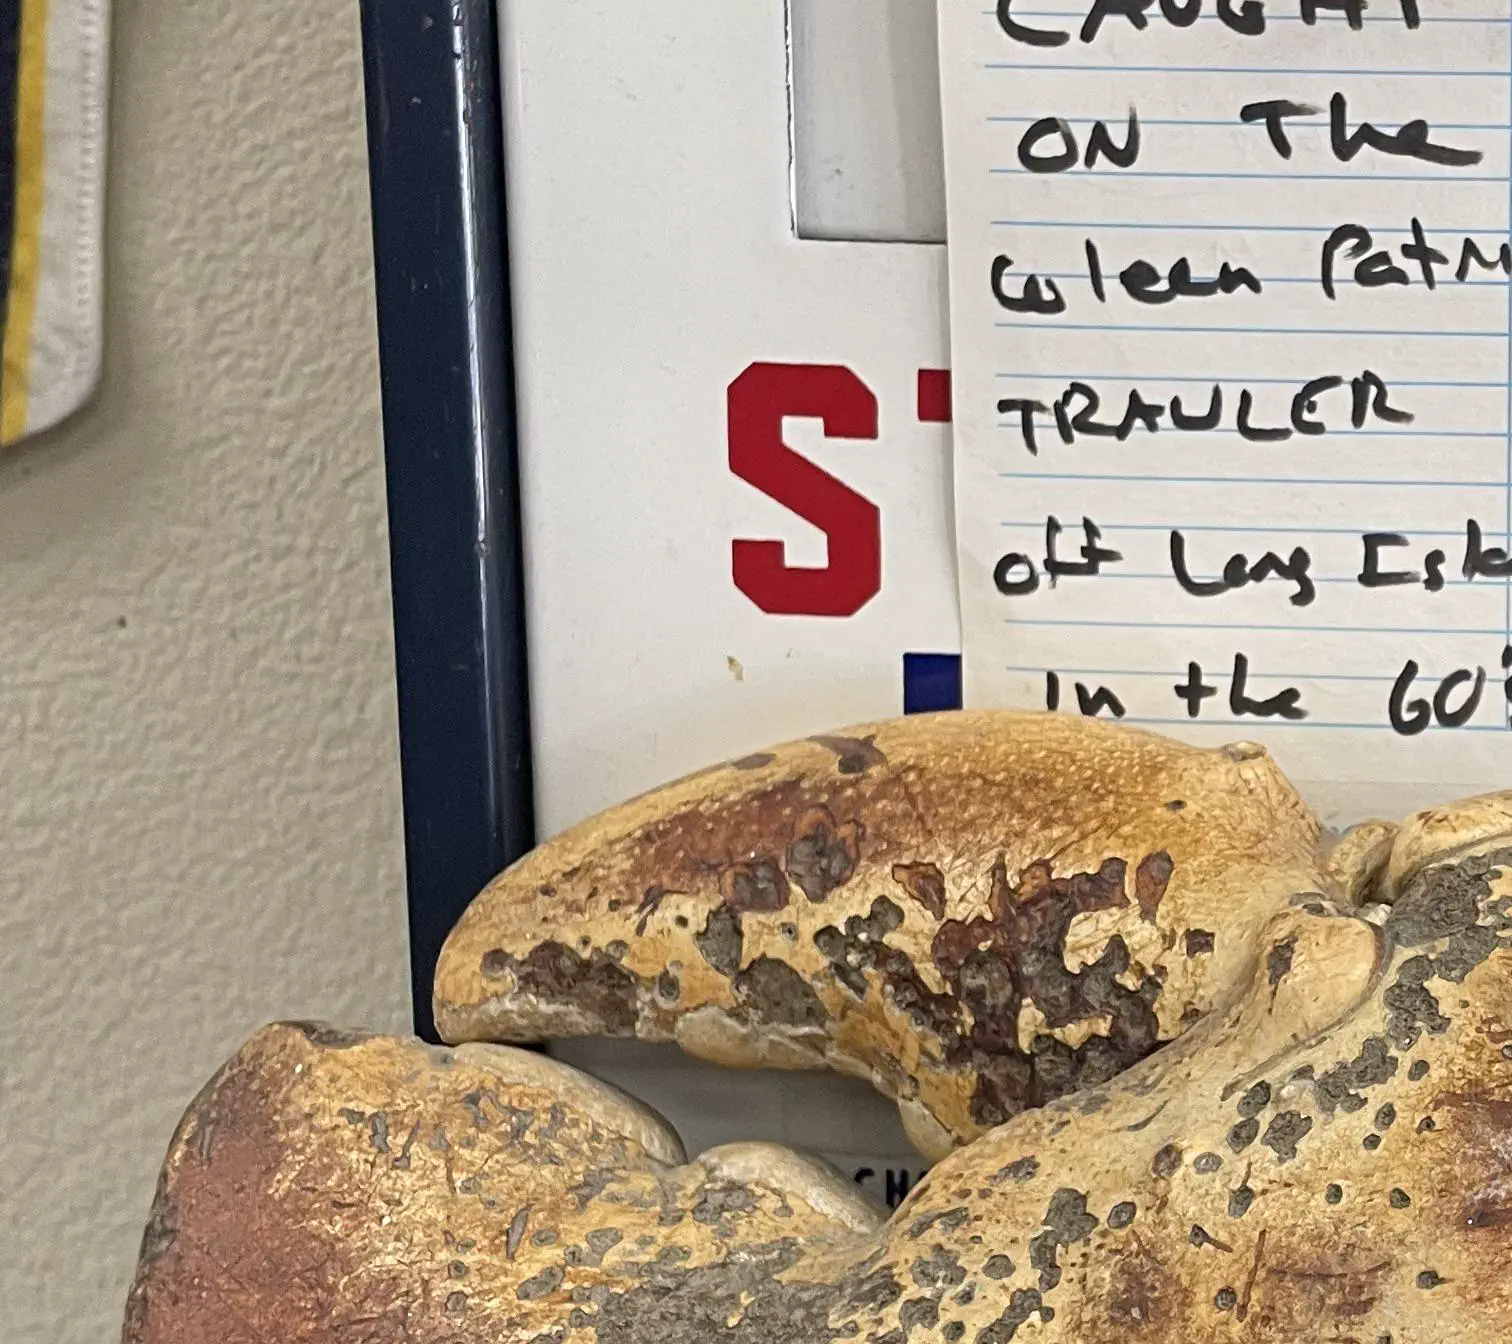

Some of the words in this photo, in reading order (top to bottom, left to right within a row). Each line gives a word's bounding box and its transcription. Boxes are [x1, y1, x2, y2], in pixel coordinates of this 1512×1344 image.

[1018, 106, 1139, 173] ON
[1240, 92, 1483, 166] The
[1175, 653, 1308, 719] the
